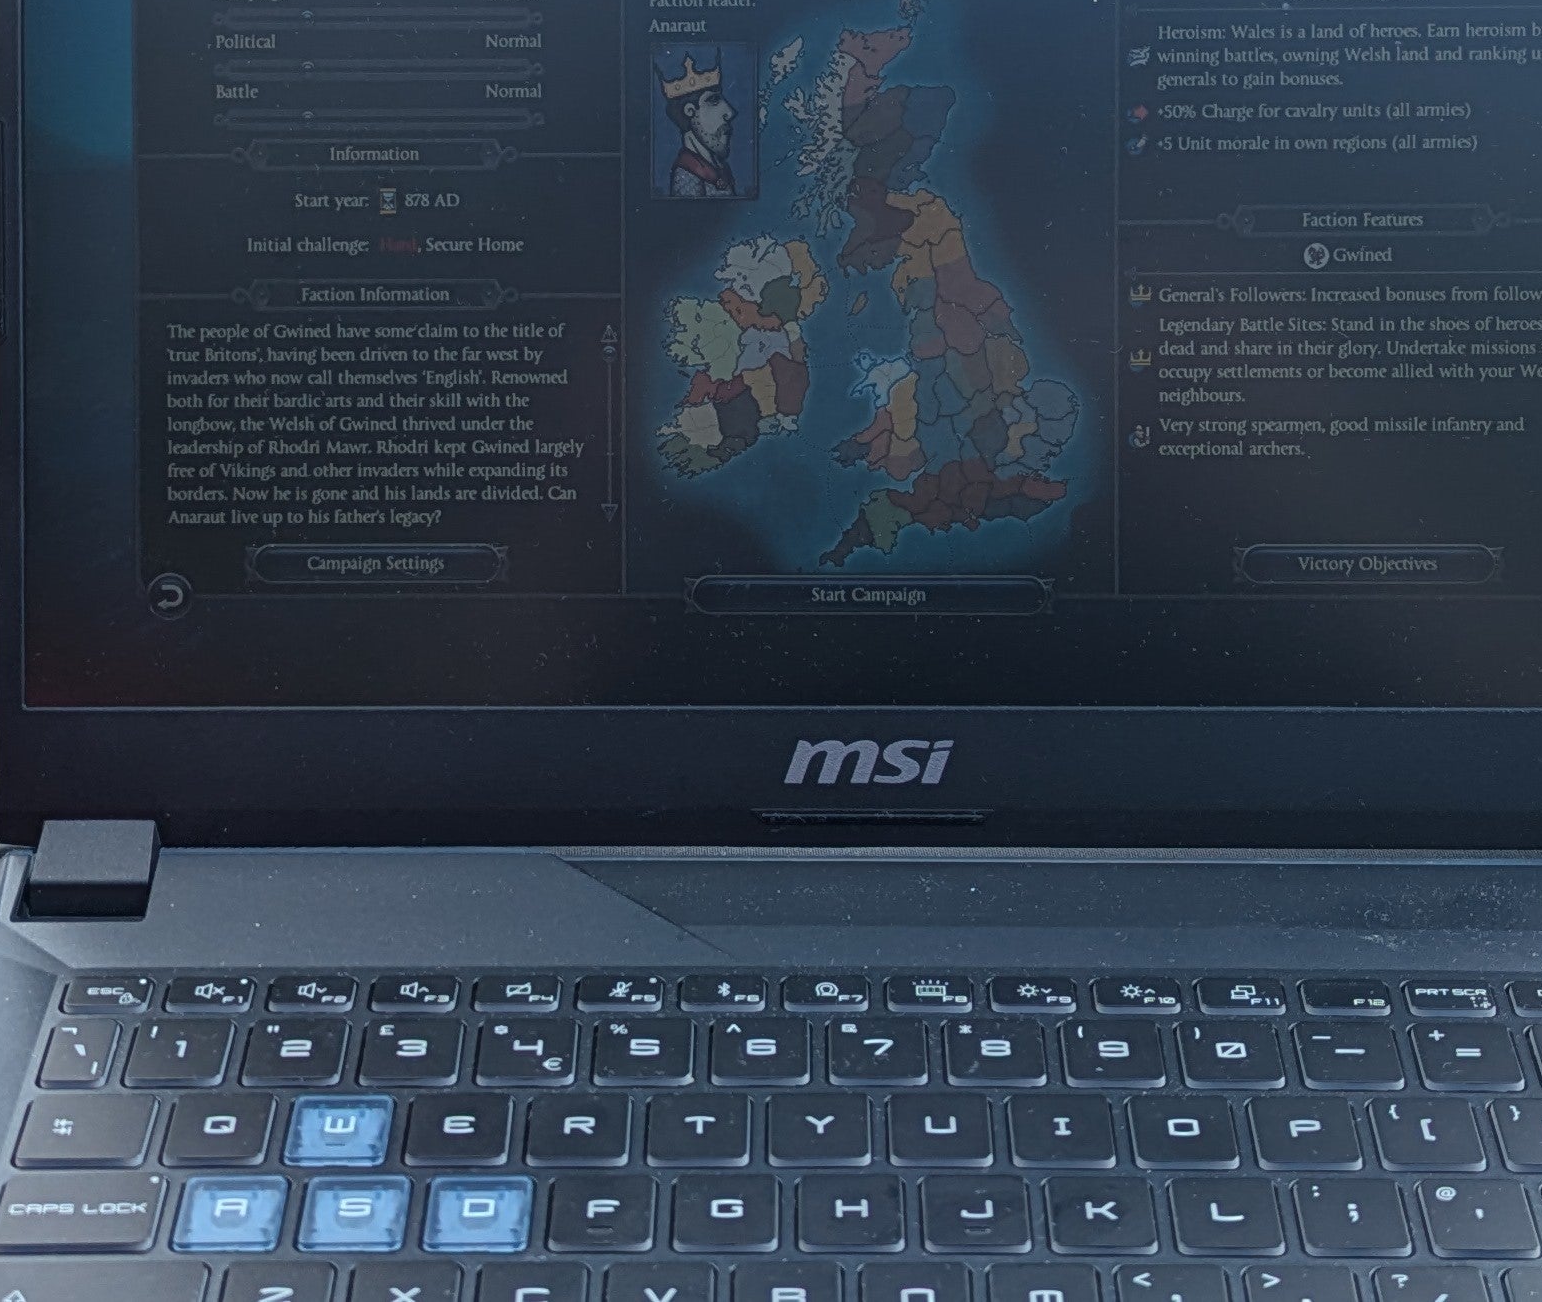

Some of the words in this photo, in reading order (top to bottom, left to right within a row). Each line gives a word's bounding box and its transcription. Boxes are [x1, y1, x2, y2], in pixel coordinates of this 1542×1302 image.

[648, 18, 707, 33] Anaraut
[1158, 25, 1226, 40] Heroism:
[1231, 23, 1276, 39] Wales
[1280, 24, 1293, 39] is
[1297, 28, 1306, 39] a
[1311, 23, 1344, 39] land
[1348, 23, 1368, 39] of
[1370, 23, 1422, 38] heroes.
[1427, 23, 1460, 38] Earn
[1465, 22, 1527, 37] heroism
[215, 33, 276, 49] Political
[485, 33, 542, 48] Normal
[1156, 50, 1220, 67] winning
[1224, 47, 1278, 65] battles,
[1282, 50, 1340, 66] owning
[1344, 46, 1391, 62] Welsh
[1396, 46, 1429, 61] land
[1435, 45, 1463, 61] and
[1469, 45, 1527, 65] ranking
[485, 82, 542, 98] Normal
[1157, 71, 1217, 91] generals
[1221, 73, 1239, 86] to
[1243, 71, 1275, 89] gain
[1280, 71, 1344, 86] bonuses.
[216, 83, 259, 99] Battle
[1157, 104, 1197, 119] +50%
[1201, 103, 1254, 122] Charge
[1258, 103, 1281, 118] for
[1284, 103, 1339, 122] cavalry
[1342, 103, 1381, 118] units
[1385, 102, 1410, 119] (all
[1416, 102, 1472, 122] armies)
[329, 145, 420, 161] Information
[1157, 136, 1173, 151] +5
[1178, 136, 1212, 151] Unit
[1217, 135, 1270, 151] morale
[1274, 139, 1290, 150] in
[1294, 138, 1328, 150] own
[1333, 137, 1387, 154] regions
[1392, 134, 1417, 152] (all
[1422, 135, 1478, 152] armies)
[295, 193, 330, 208] Start
[334, 196, 370, 212] year:
[404, 193, 430, 207] 878
[434, 193, 460, 207] AD
[1302, 212, 1358, 227] Faction
[1363, 212, 1424, 227] Features
[247, 237, 292, 253] Initial
[297, 236, 370, 256] challenge:
[425, 236, 474, 253] Secure
[478, 237, 526, 253] Home
[1333, 245, 1393, 262] Gwined
[302, 287, 355, 302] Faction
[360, 286, 450, 302] Information
[166, 323, 196, 339] The
[200, 323, 250, 343] people
[253, 323, 271, 338] of
[273, 323, 332, 339] Gwined
[336, 323, 371, 338] have
[374, 326, 417, 338] some
[417, 322, 458, 338] claim
[463, 326, 480, 338] to
[483, 322, 509, 338] the
[512, 322, 545, 338] title
[547, 322, 566, 338] of
[266, 346, 318, 366] having
[320, 346, 355, 362] been
[359, 346, 408, 362] driven
[412, 349, 429, 362] to
[433, 346, 459, 362] the
[461, 346, 483, 362] far
[485, 348, 519, 362] west
[524, 346, 544, 365] by
[167, 370, 230, 385] invaders
[233, 369, 266, 385] who
[271, 373, 303, 385] now
[307, 369, 332, 385] call
[338, 369, 418, 385] themselves
[491, 368, 568, 385] Renowned
[307, 551, 381, 575] Campaign
[386, 555, 445, 574] Settings
[1298, 556, 1355, 576] Victory
[1358, 555, 1438, 575] Objectives
[811, 587, 846, 603] Start
[851, 587, 926, 606] Campaign
[784, 740, 955, 784] msi
[86, 987, 126, 997] ESC
[175, 1040, 188, 1058] 1
[280, 1039, 313, 1058] 2
[396, 1039, 428, 1057] 3
[513, 1039, 544, 1056] 4
[629, 1038, 660, 1056] 5
[746, 1038, 777, 1056] 6
[863, 1038, 894, 1056] 7
[980, 1039, 1012, 1057] 8
[1097, 1040, 1130, 1058] 9
[203, 1115, 237, 1134] Q
[323, 1115, 356, 1134] W
[443, 1115, 476, 1134] E
[563, 1116, 596, 1135] R
[684, 1115, 716, 1135] T
[805, 1115, 835, 1134] Y
[924, 1115, 957, 1134] U
[1053, 1117, 1072, 1136] I
[1167, 1118, 1201, 1136] O
[1289, 1119, 1321, 1138] P
[7, 1203, 75, 1216] CAPS
[81, 1202, 148, 1215] LOCK
[214, 1197, 248, 1217] A
[338, 1197, 372, 1217] S
[462, 1198, 496, 1218] D
[586, 1199, 621, 1219] F
[710, 1198, 744, 1218] G
[835, 1198, 869, 1218] H
[960, 1199, 994, 1219] J
[1084, 1201, 1119, 1220] K
[1210, 1202, 1245, 1222] L
